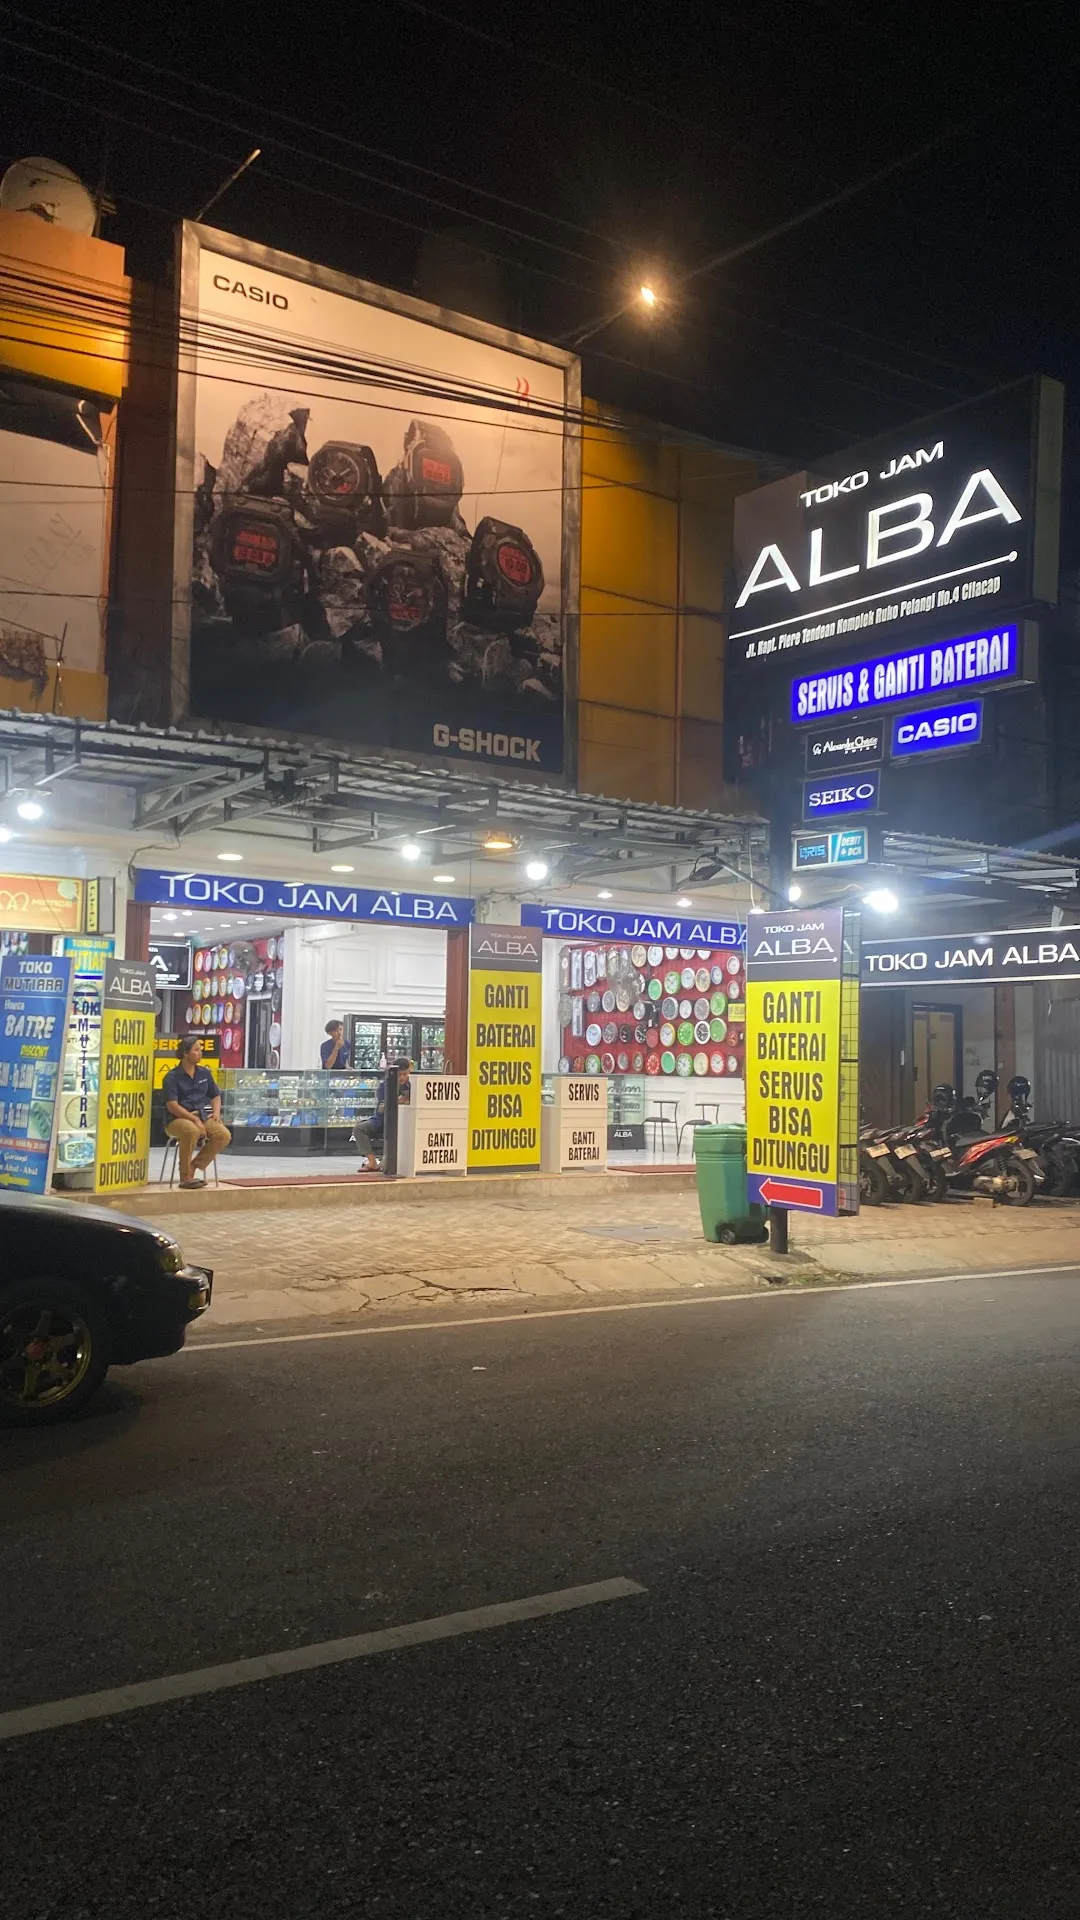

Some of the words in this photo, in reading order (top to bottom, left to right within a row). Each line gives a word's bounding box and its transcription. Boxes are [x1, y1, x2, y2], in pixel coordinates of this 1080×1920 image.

[213, 274, 289, 310] CASIO
[800, 471, 869, 508] TOKO
[880, 440, 944, 479] JAM
[735, 468, 1022, 609] ALBA
[746, 644, 757, 658] Jl.
[758, 635, 778, 656] Kapt.
[801, 621, 835, 645] Tendean
[836, 610, 874, 634] Komplek
[876, 604, 899, 624] Ruko
[900, 592, 935, 617] Pelangi
[937, 584, 960, 607] No.4
[961, 576, 1001, 601] Cilacap
[797, 671, 854, 717] SERVIS
[857, 667, 870, 704] &
[873, 653, 925, 700] GANTI
[930, 631, 1010, 688] BATERAI
[897, 712, 978, 744] CASIO
[433, 723, 541, 762] G-SHOCK
[808, 783, 874, 807] SEIKO
[160, 875, 264, 905] TOKO
[278, 888, 357, 913] JAM
[370, 896, 459, 922] ALBA
[541, 909, 615, 934] TOKO
[624, 918, 681, 940] JAM
[763, 925, 795, 935] TOKO
[797, 922, 825, 932] JAM
[477, 940, 538, 957] ALBA
[753, 937, 835, 957] ALBA
[865, 952, 928, 972] TOKO
[935, 948, 994, 969] JAM
[1002, 943, 1080, 966] ALBA
[17, 961, 54, 974] TOKO
[3, 976, 65, 993] MUTIARA
[109, 976, 154, 998] ALBA
[484, 983, 530, 1010] GANTI
[762, 990, 822, 1024] GANTI
[5, 1014, 57, 1040] BATRE
[112, 1018, 146, 1047] GANTI
[476, 1022, 536, 1049] BATERAI
[757, 1032, 827, 1062] BATERAI
[105, 1053, 149, 1082] BATERAI
[479, 1060, 532, 1086] SERVIS
[425, 1081, 460, 1101] SERVIS
[568, 1083, 599, 1101] SERVIS
[759, 1070, 823, 1102] SERVIS
[106, 1091, 145, 1120] SERVIS
[487, 1093, 523, 1119] BISA
[769, 1106, 813, 1137] BISA
[111, 1127, 137, 1156] BISA
[253, 1134, 281, 1142] ALBA
[427, 1132, 454, 1147] GANTI
[471, 1127, 537, 1150] DITUNGGU
[572, 1131, 595, 1146] GANTI
[422, 1149, 458, 1164] BATERAI
[568, 1146, 600, 1161] BATERAI
[752, 1137, 831, 1174] DITUNGGU
[99, 1158, 147, 1188] DITUNGGU
